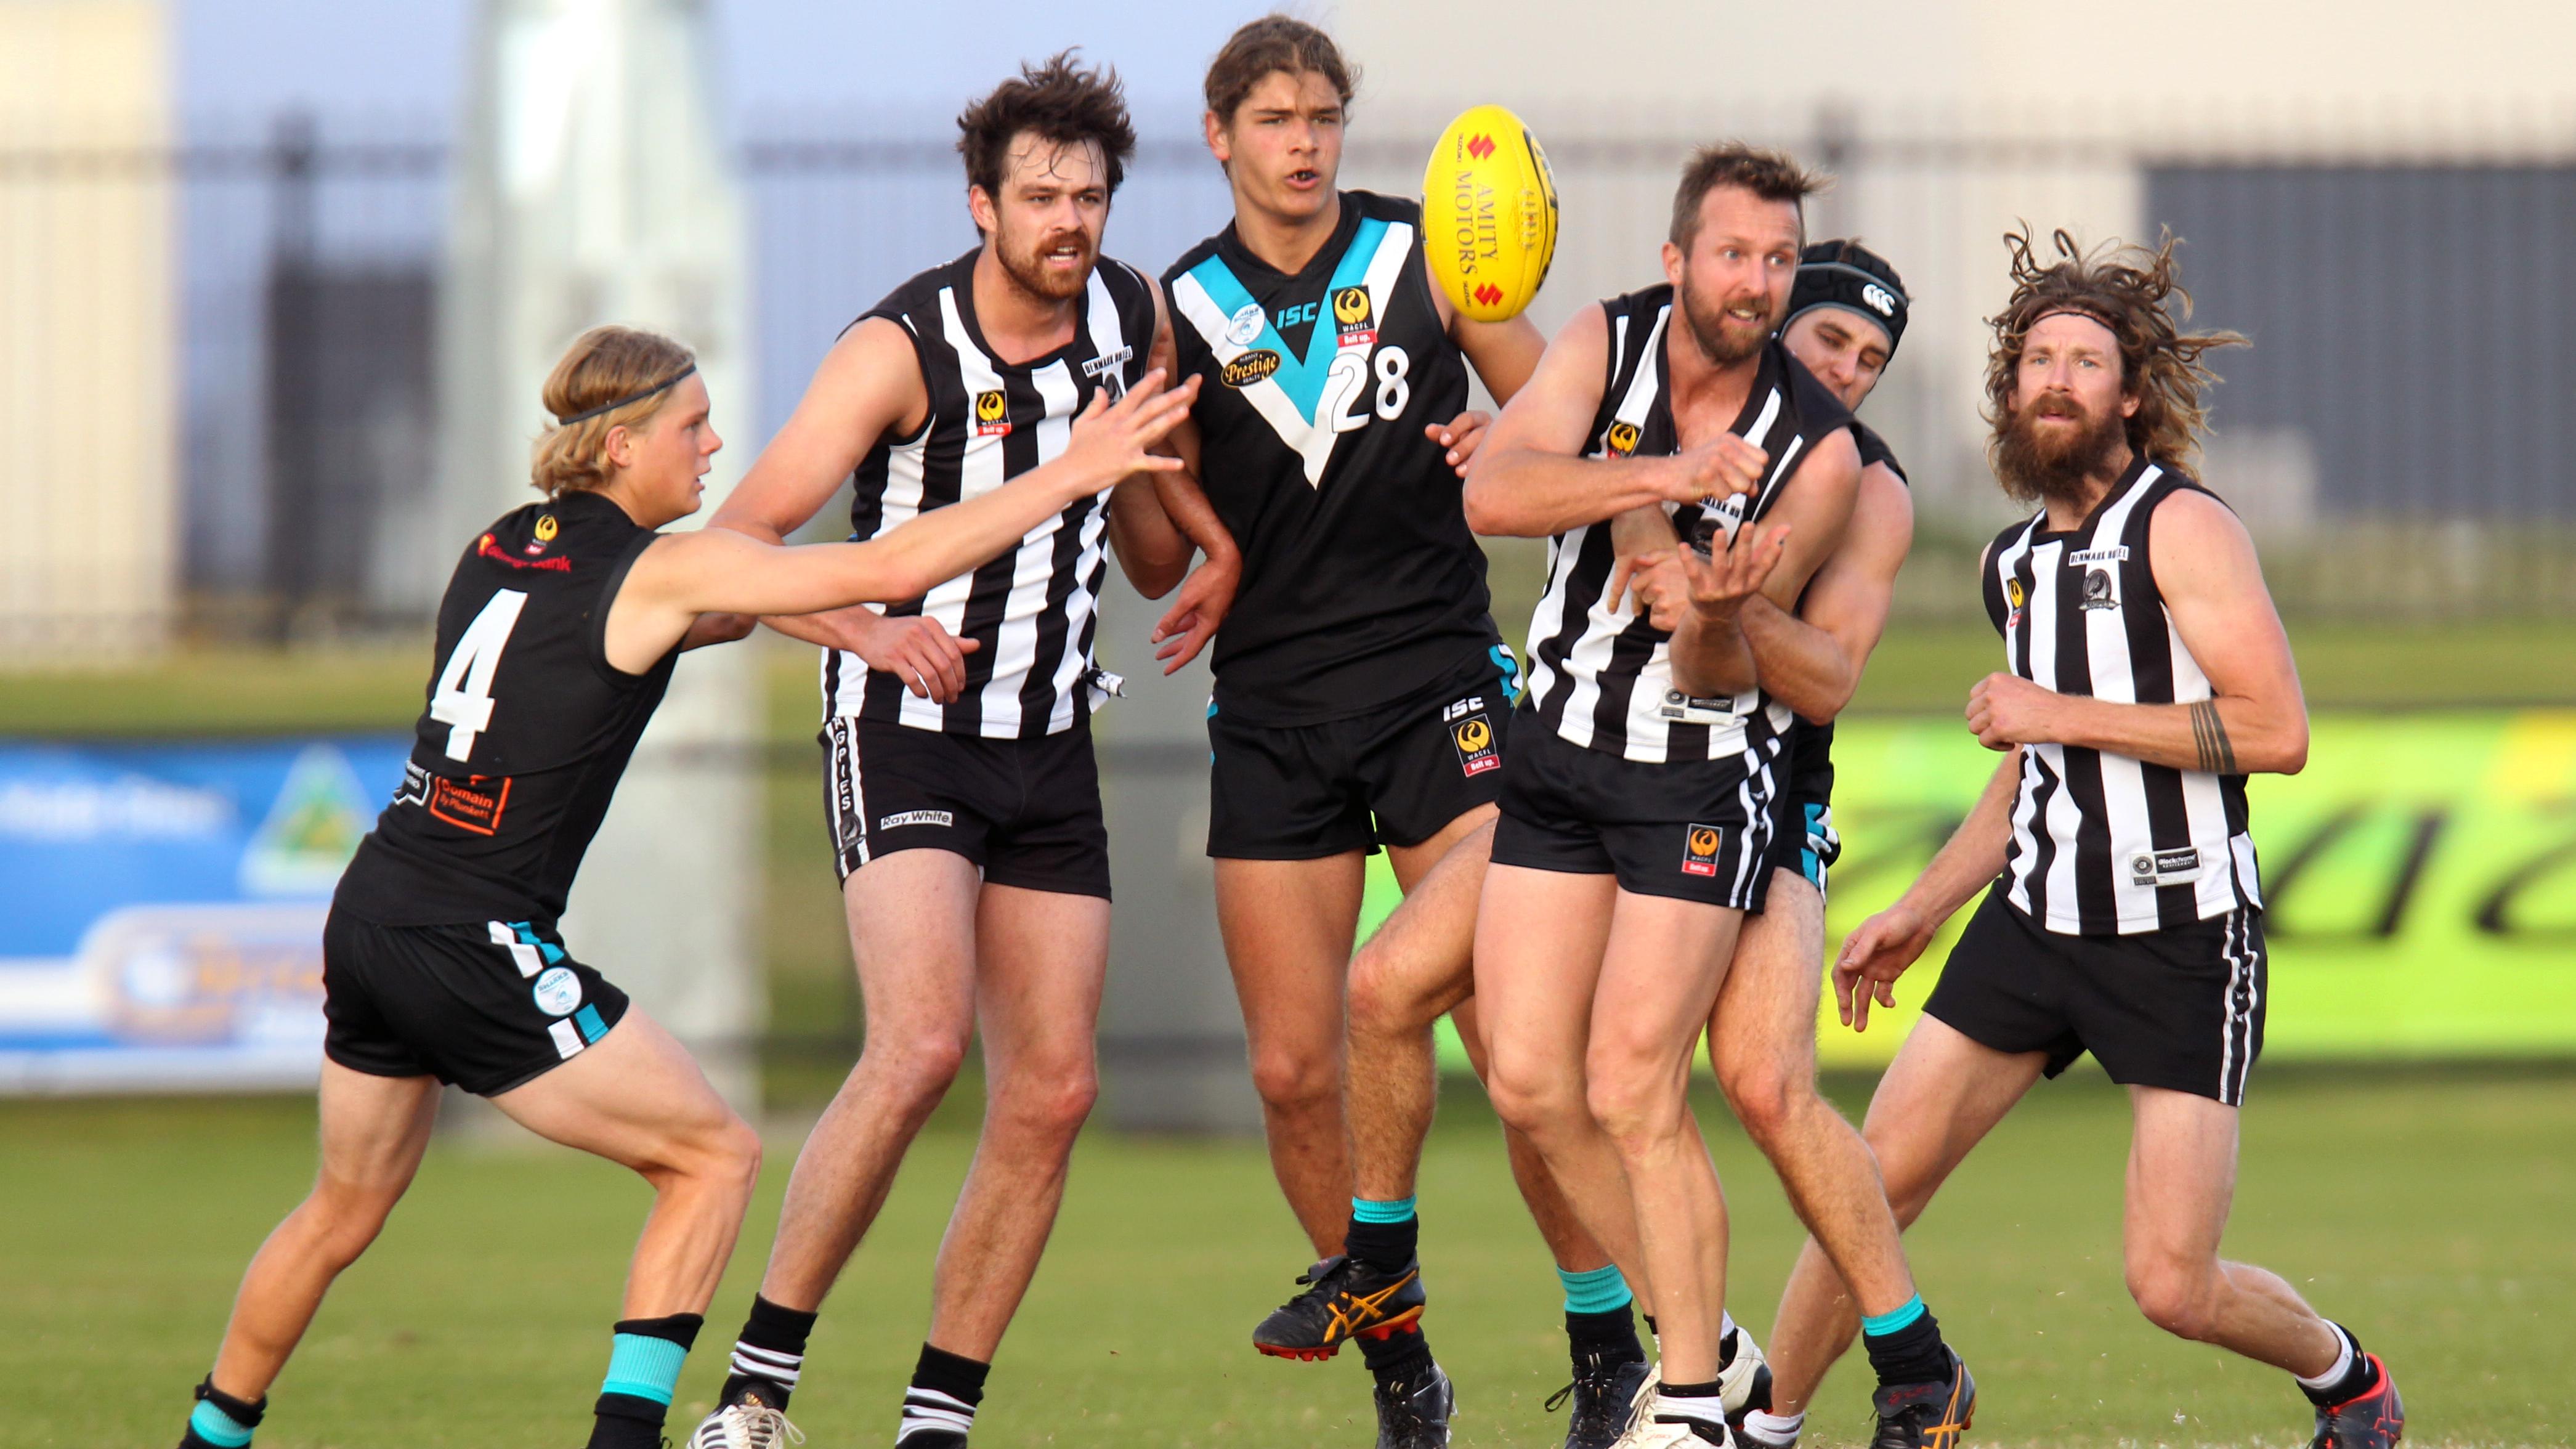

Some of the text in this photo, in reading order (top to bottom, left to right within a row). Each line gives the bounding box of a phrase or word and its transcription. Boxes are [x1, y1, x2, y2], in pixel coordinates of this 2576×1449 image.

[1455, 171, 1478, 275] MOTORS
[1477, 184, 1498, 262] AMITY
[1276, 302, 1317, 330] ISC
[1344, 333, 1358, 345] Belt
[1084, 354, 1113, 374] DENMARK
[1225, 354, 1276, 382] Prestige
[1239, 353, 1258, 363] ALBANY
[1243, 374, 1260, 383] REALTY
[1328, 346, 1409, 434] 28
[2070, 548, 2126, 564] DENMARK HOTEL
[430, 588, 528, 763] 4
[1443, 697, 1483, 722] ISC
[1467, 749, 1491, 761] WACFL
[1470, 760, 1484, 771] Belt
[442, 779, 493, 808] Domain
[449, 797, 490, 819] Plunkett
[883, 815, 909, 827] Ray
